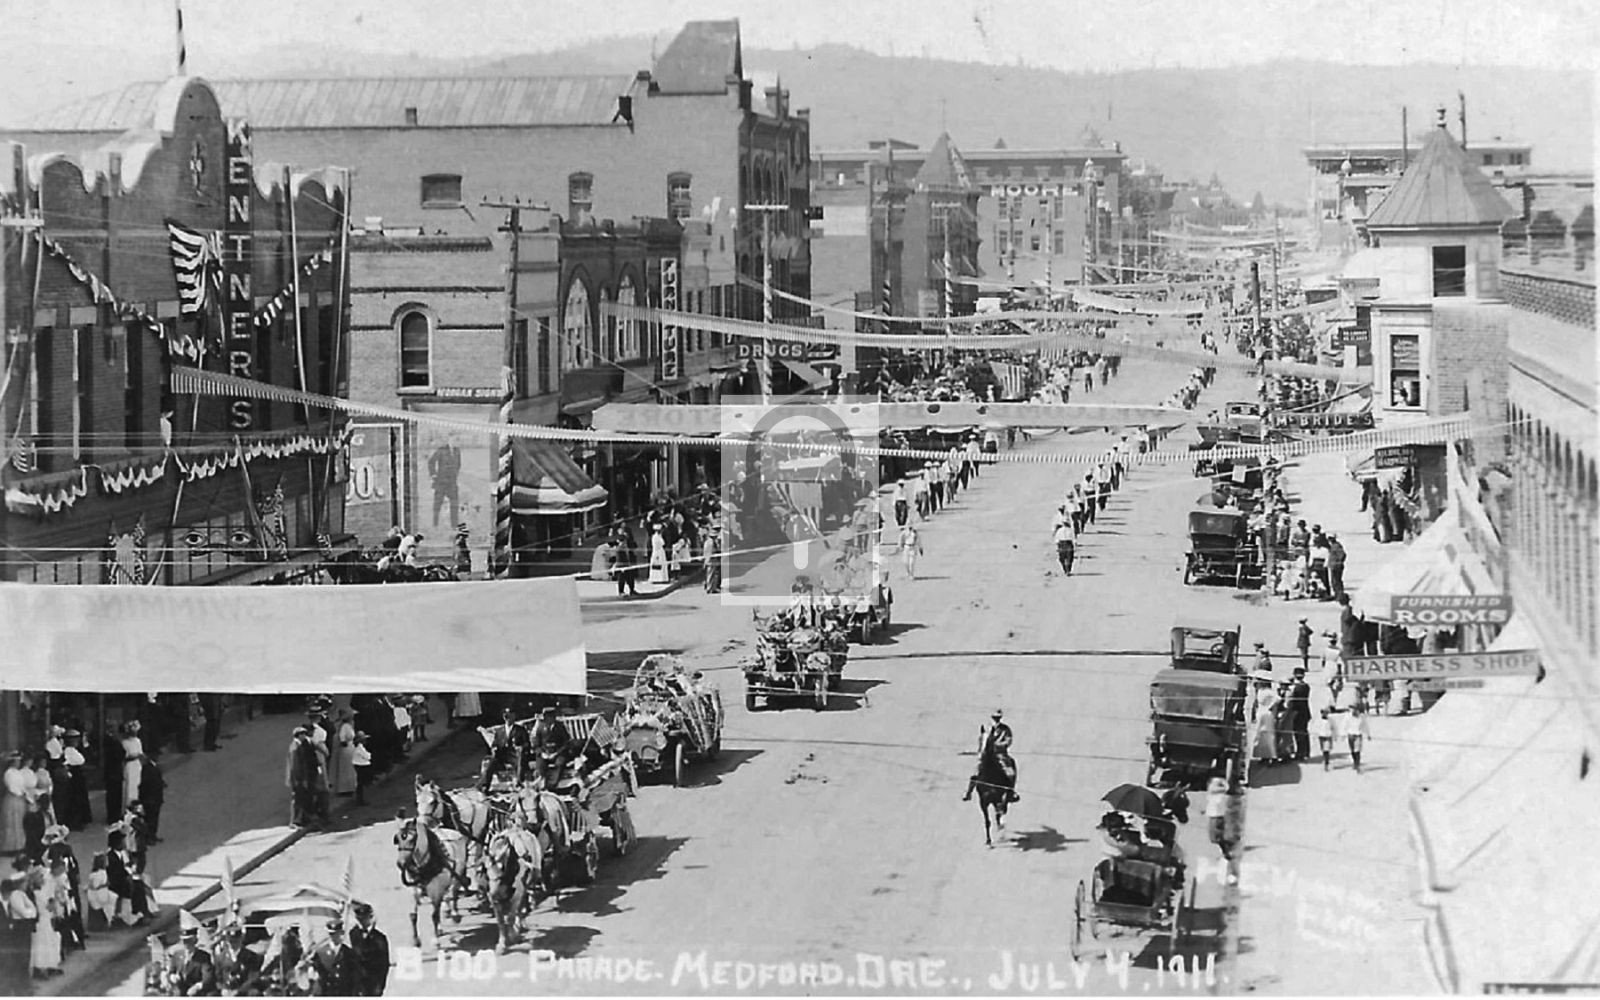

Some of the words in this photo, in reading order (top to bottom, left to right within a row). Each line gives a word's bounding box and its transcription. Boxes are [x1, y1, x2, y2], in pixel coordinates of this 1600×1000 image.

[227, 118, 252, 428] KENTNERS
[663, 259, 677, 378] FURNTURE
[1399, 597, 1502, 607] FURNISHED
[1394, 609, 1508, 623] ROOMS
[1351, 658, 1462, 675] HARNESS
[1473, 653, 1537, 670] SHOP
